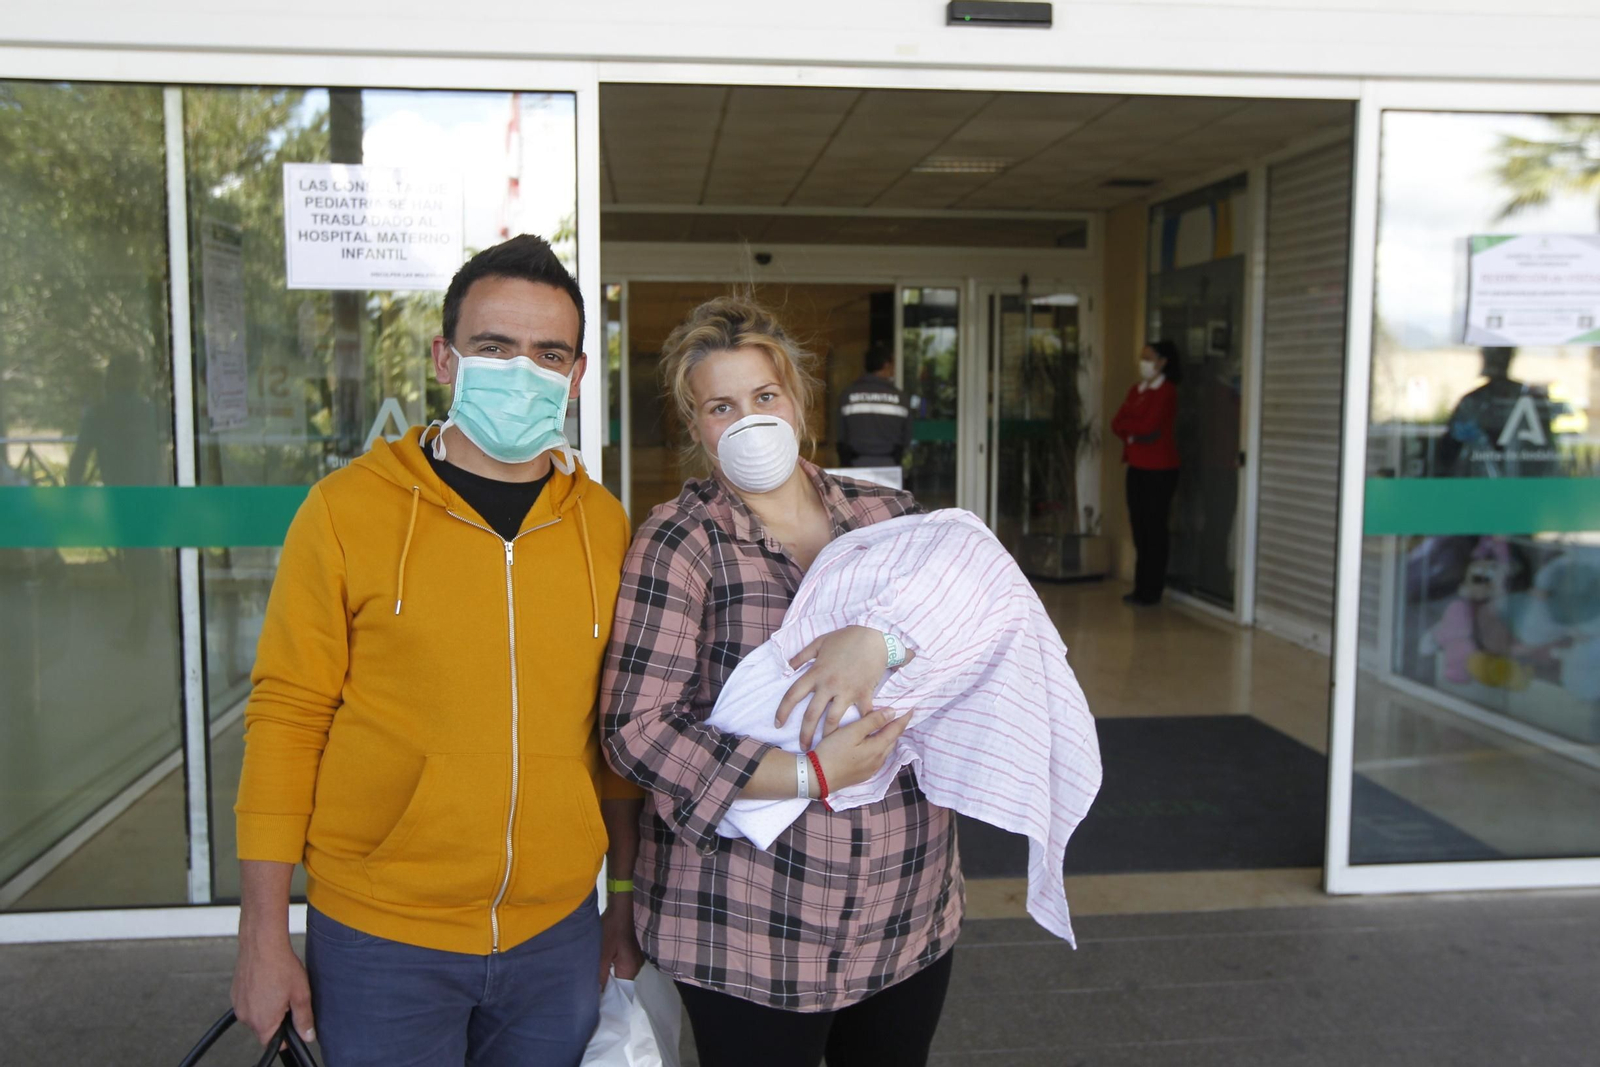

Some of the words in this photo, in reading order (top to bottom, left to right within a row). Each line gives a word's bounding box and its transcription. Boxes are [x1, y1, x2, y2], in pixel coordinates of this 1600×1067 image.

[298, 179, 328, 192] LAS
[388, 198, 407, 210] SE
[412, 199, 443, 211] HAN
[311, 213, 414, 227] TRASLADADO
[418, 216, 437, 227] AL
[298, 230, 371, 243] HOSPITAL
[377, 232, 450, 245] MATERNO
[341, 248, 408, 261] INFANTIL
